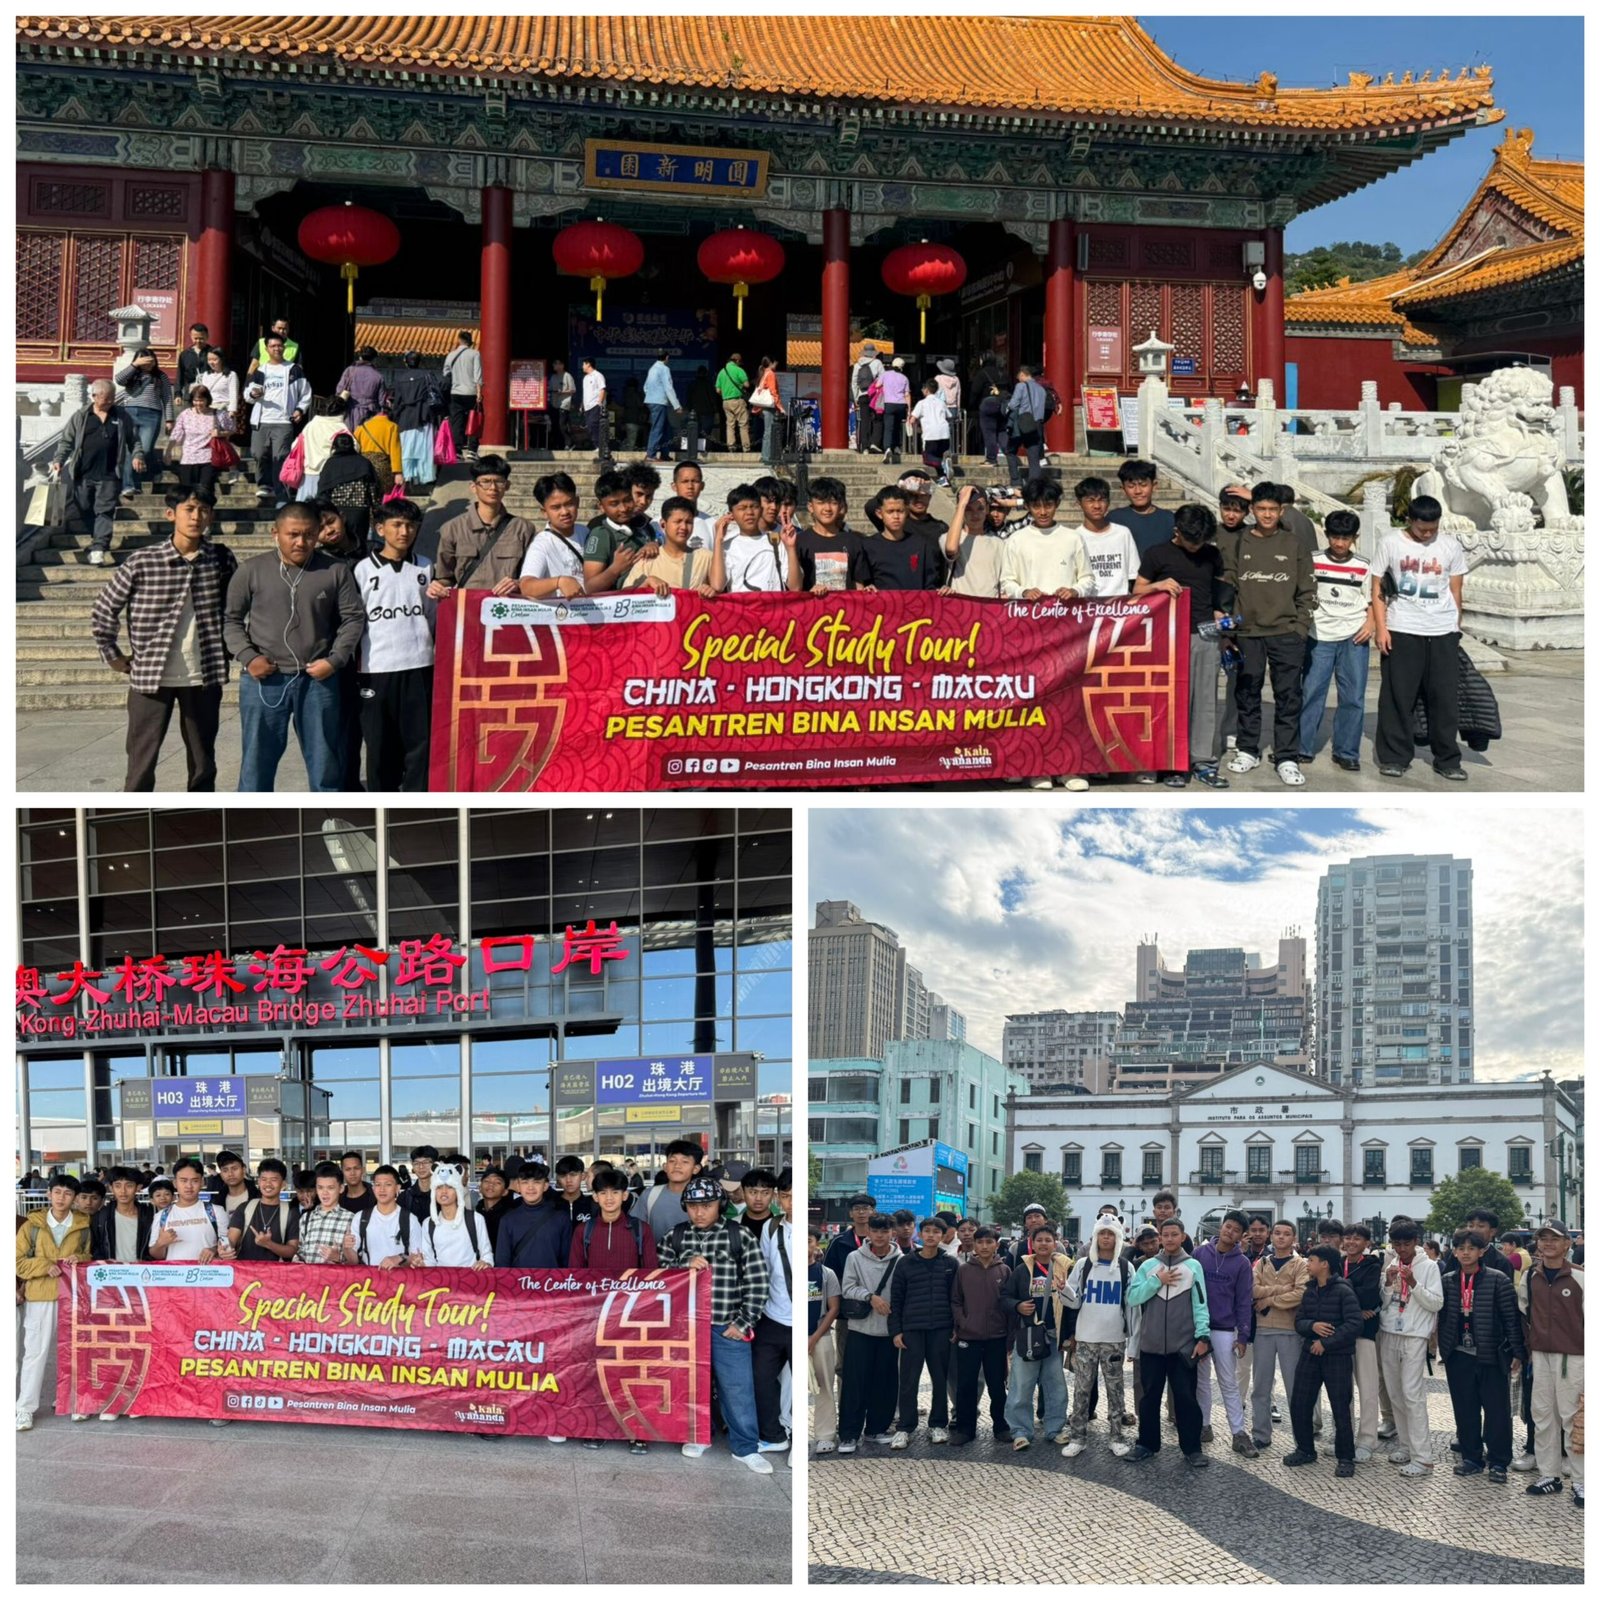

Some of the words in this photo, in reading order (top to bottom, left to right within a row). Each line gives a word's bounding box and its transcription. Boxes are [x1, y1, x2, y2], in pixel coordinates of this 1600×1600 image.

[369, 576, 380, 591] 7
[1004, 600, 1029, 618] The
[1031, 599, 1069, 620] Center
[1071, 603, 1085, 624] of
[1086, 601, 1150, 618] Excellence
[1318, 598, 1355, 607] napdragon
[682, 613, 797, 677] Special
[804, 608, 896, 674] Study
[896, 618, 981, 669] Tour!
[623, 677, 717, 706] CHINA
[745, 675, 902, 703] HONGKONG
[931, 674, 1035, 700] MACAU
[605, 712, 784, 739] PESANTREN
[792, 710, 861, 734] BINA
[868, 708, 955, 733] INSAN
[963, 706, 1047, 731] MULIA
[744, 759, 803, 771] Pesantren
[806, 758, 831, 770] Bina
[833, 757, 864, 768] Insan
[866, 756, 896, 767] Mulia
[257, 998, 337, 1027] Bridge
[342, 992, 427, 1018] Zhuhai
[436, 987, 491, 1015] Port
[601, 1074, 634, 1090] H02
[642, 1076, 703, 1093] 出境大厅
[157, 1091, 184, 1105] H03
[190, 1095, 238, 1108] 出境大厅
[518, 1275, 541, 1291] The
[543, 1273, 582, 1292] Center
[585, 1279, 599, 1297] of
[600, 1276, 666, 1291] Excellence
[237, 1280, 331, 1331] Special
[338, 1277, 416, 1334] Study
[417, 1287, 496, 1333] Tour!
[194, 1330, 265, 1352] CHINA
[288, 1331, 421, 1359] HONGKONG
[447, 1336, 545, 1364] MACAU
[180, 1358, 321, 1380] PESANTREN
[326, 1362, 385, 1383] BINA
[391, 1365, 469, 1388] INSAN
[475, 1370, 560, 1393] MULIA
[286, 1400, 334, 1410] Pesantren
[336, 1401, 359, 1411] Bina
[360, 1403, 387, 1413] Insan
[388, 1404, 416, 1414] Mulia
